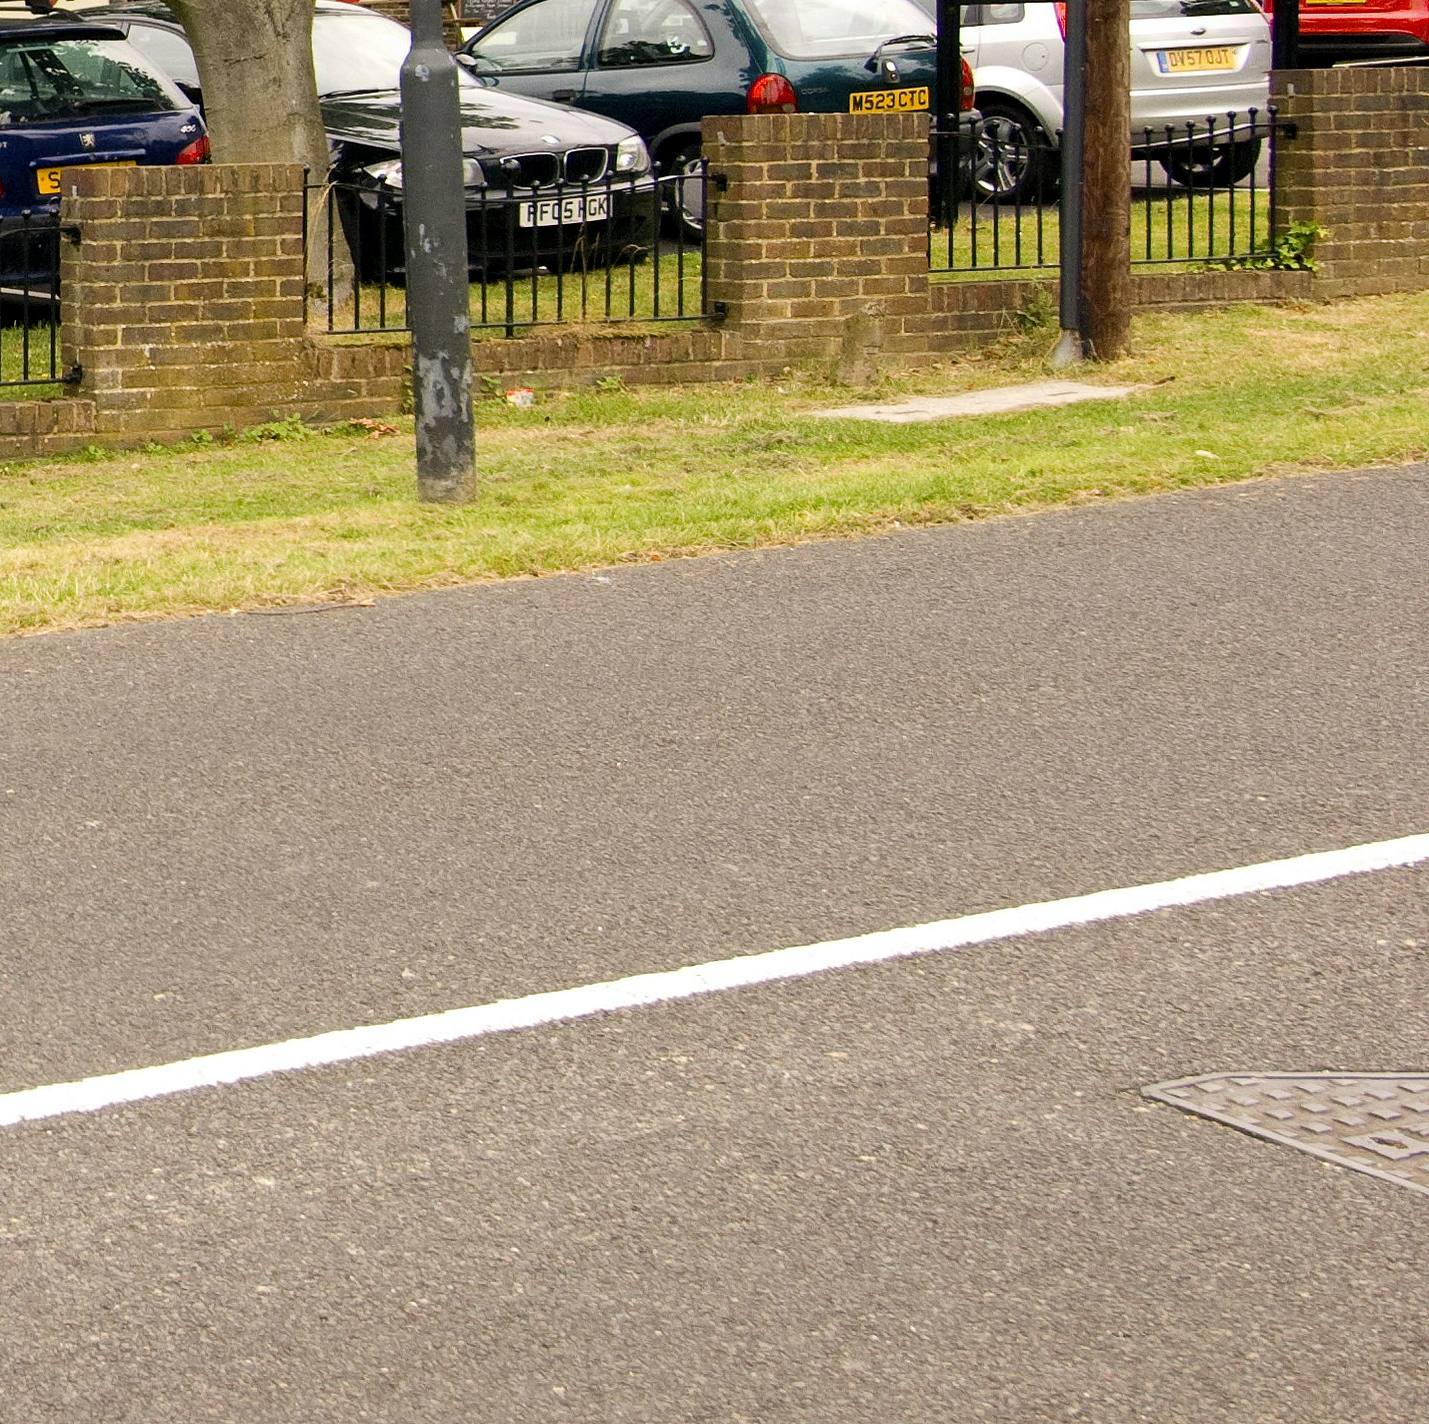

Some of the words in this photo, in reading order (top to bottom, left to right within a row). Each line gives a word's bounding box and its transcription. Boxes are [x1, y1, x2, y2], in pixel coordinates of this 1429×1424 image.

[1170, 50, 1202, 67] DV57
[852, 92, 896, 112] M523
[898, 89, 927, 108] CTC
